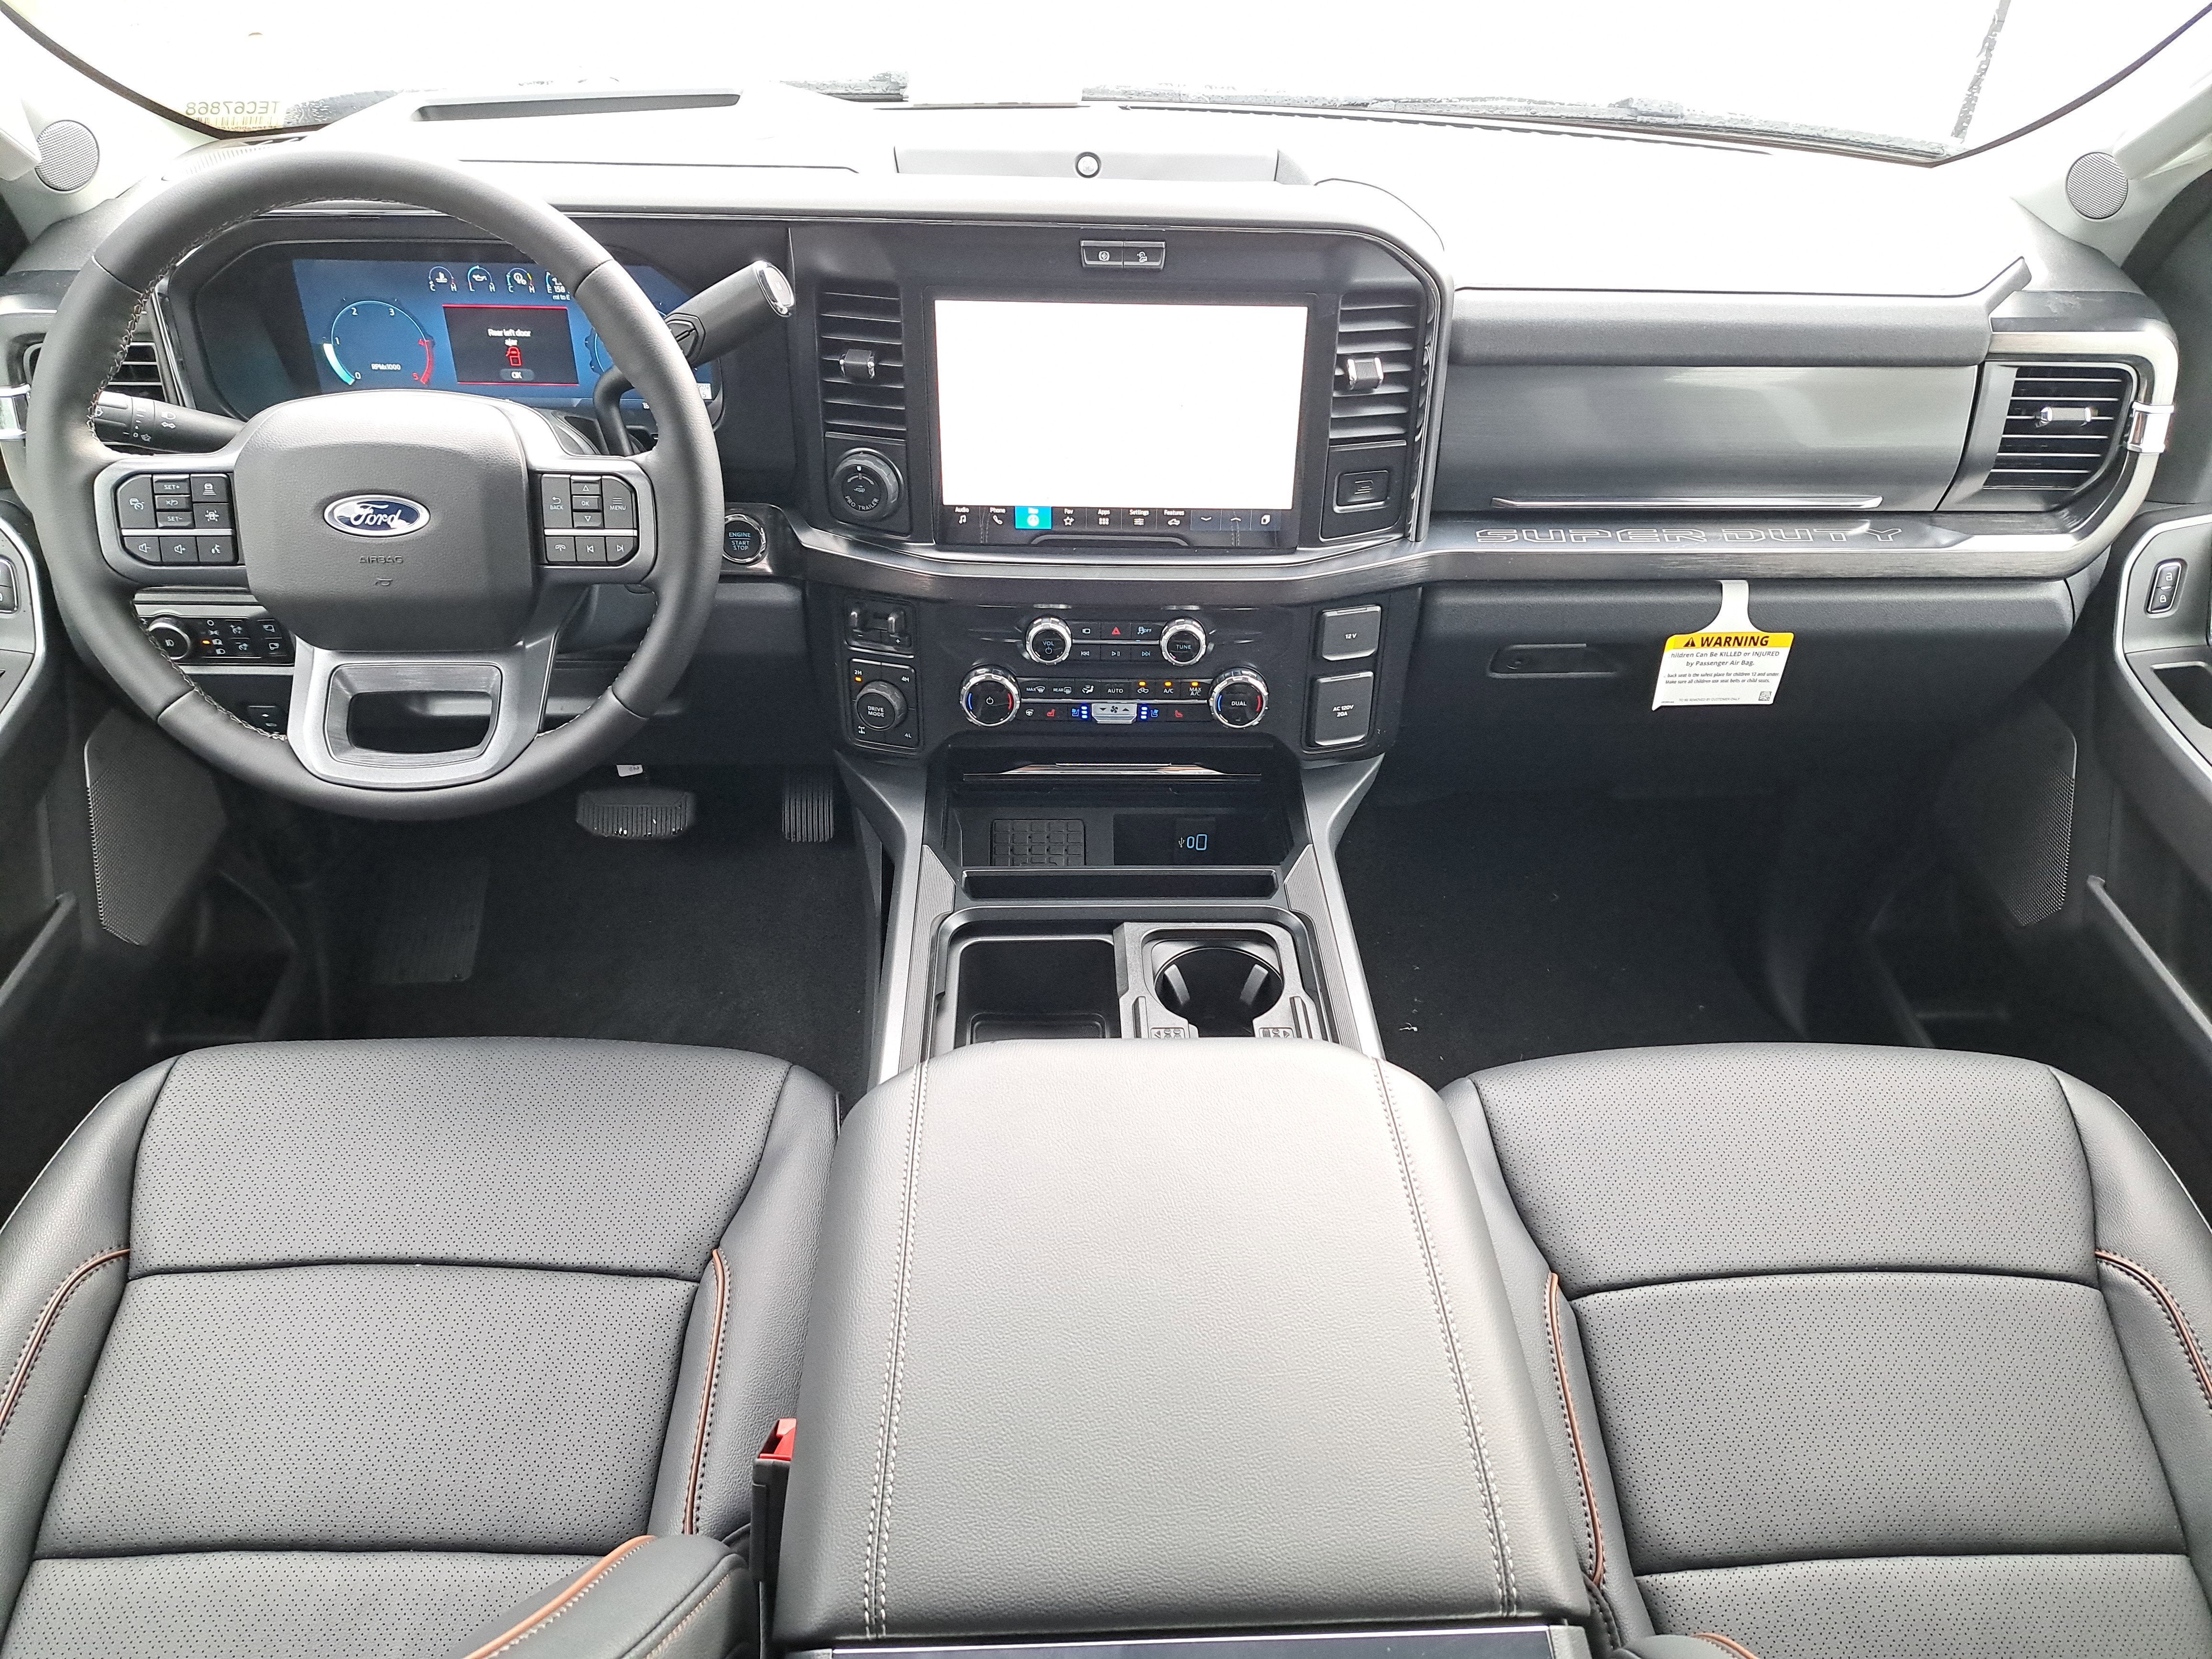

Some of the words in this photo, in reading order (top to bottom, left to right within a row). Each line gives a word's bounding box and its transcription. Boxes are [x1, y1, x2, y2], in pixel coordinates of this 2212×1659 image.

[511, 371, 522, 379] OK
[845, 496, 856, 507] PRO
[858, 498, 880, 510] TRAILER
[350, 503, 402, 525] Ford
[1475, 528, 1708, 544] SUPER
[1722, 528, 1902, 542] DUTY
[359, 555, 403, 564] AIRBAG
[1701, 635, 1770, 647] WARNING
